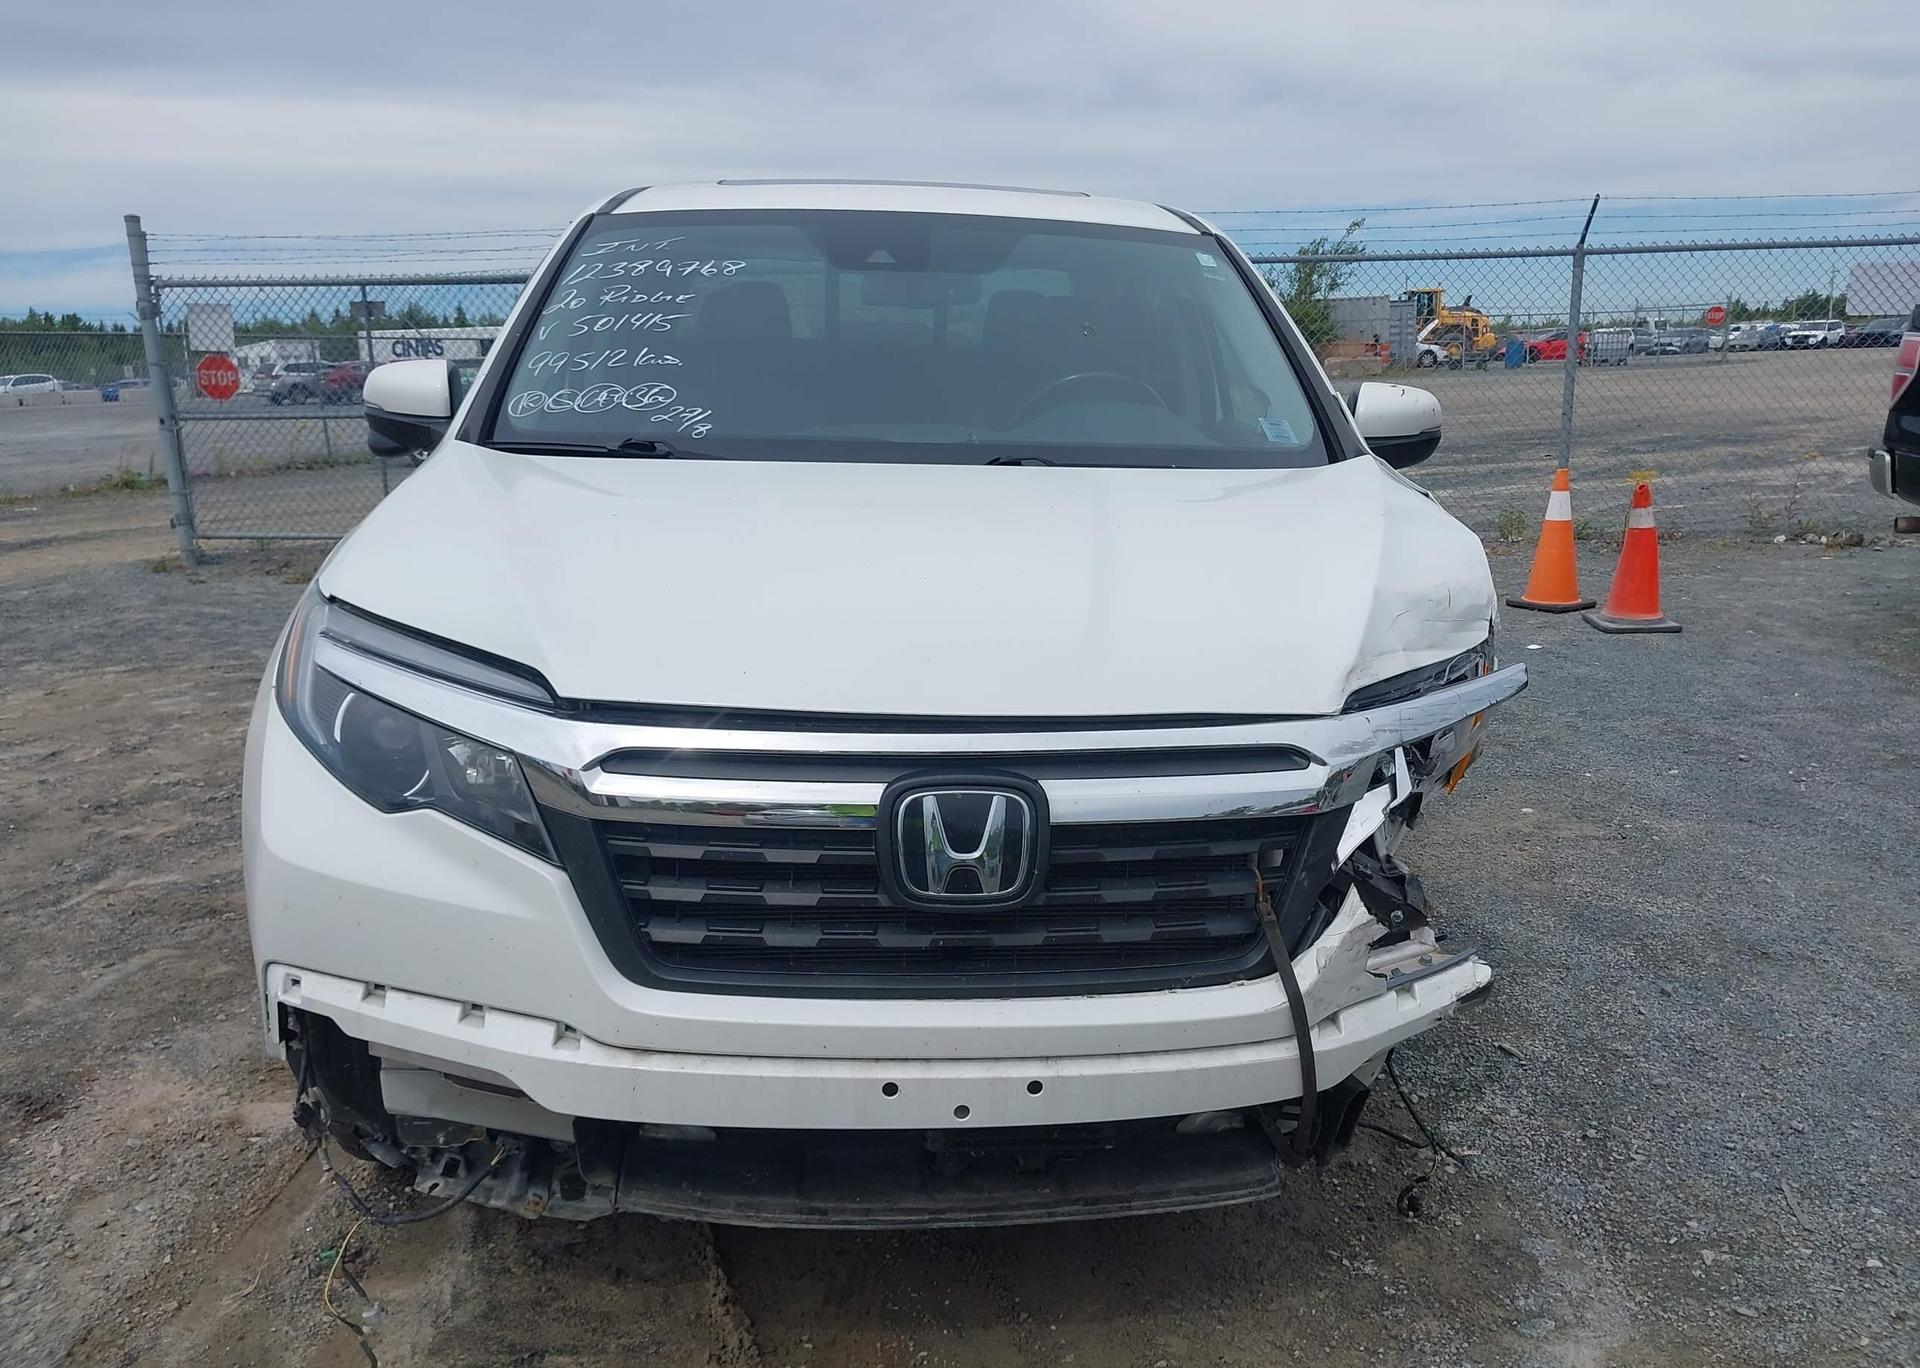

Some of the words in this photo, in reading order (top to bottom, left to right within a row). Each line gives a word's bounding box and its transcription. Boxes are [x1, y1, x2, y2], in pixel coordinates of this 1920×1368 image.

[561, 259, 747, 286] 12389768
[568, 312, 694, 337] 501415
[392, 339, 444, 358] CINTAS
[528, 349, 629, 376] 99512
[200, 369, 237, 386] STOP
